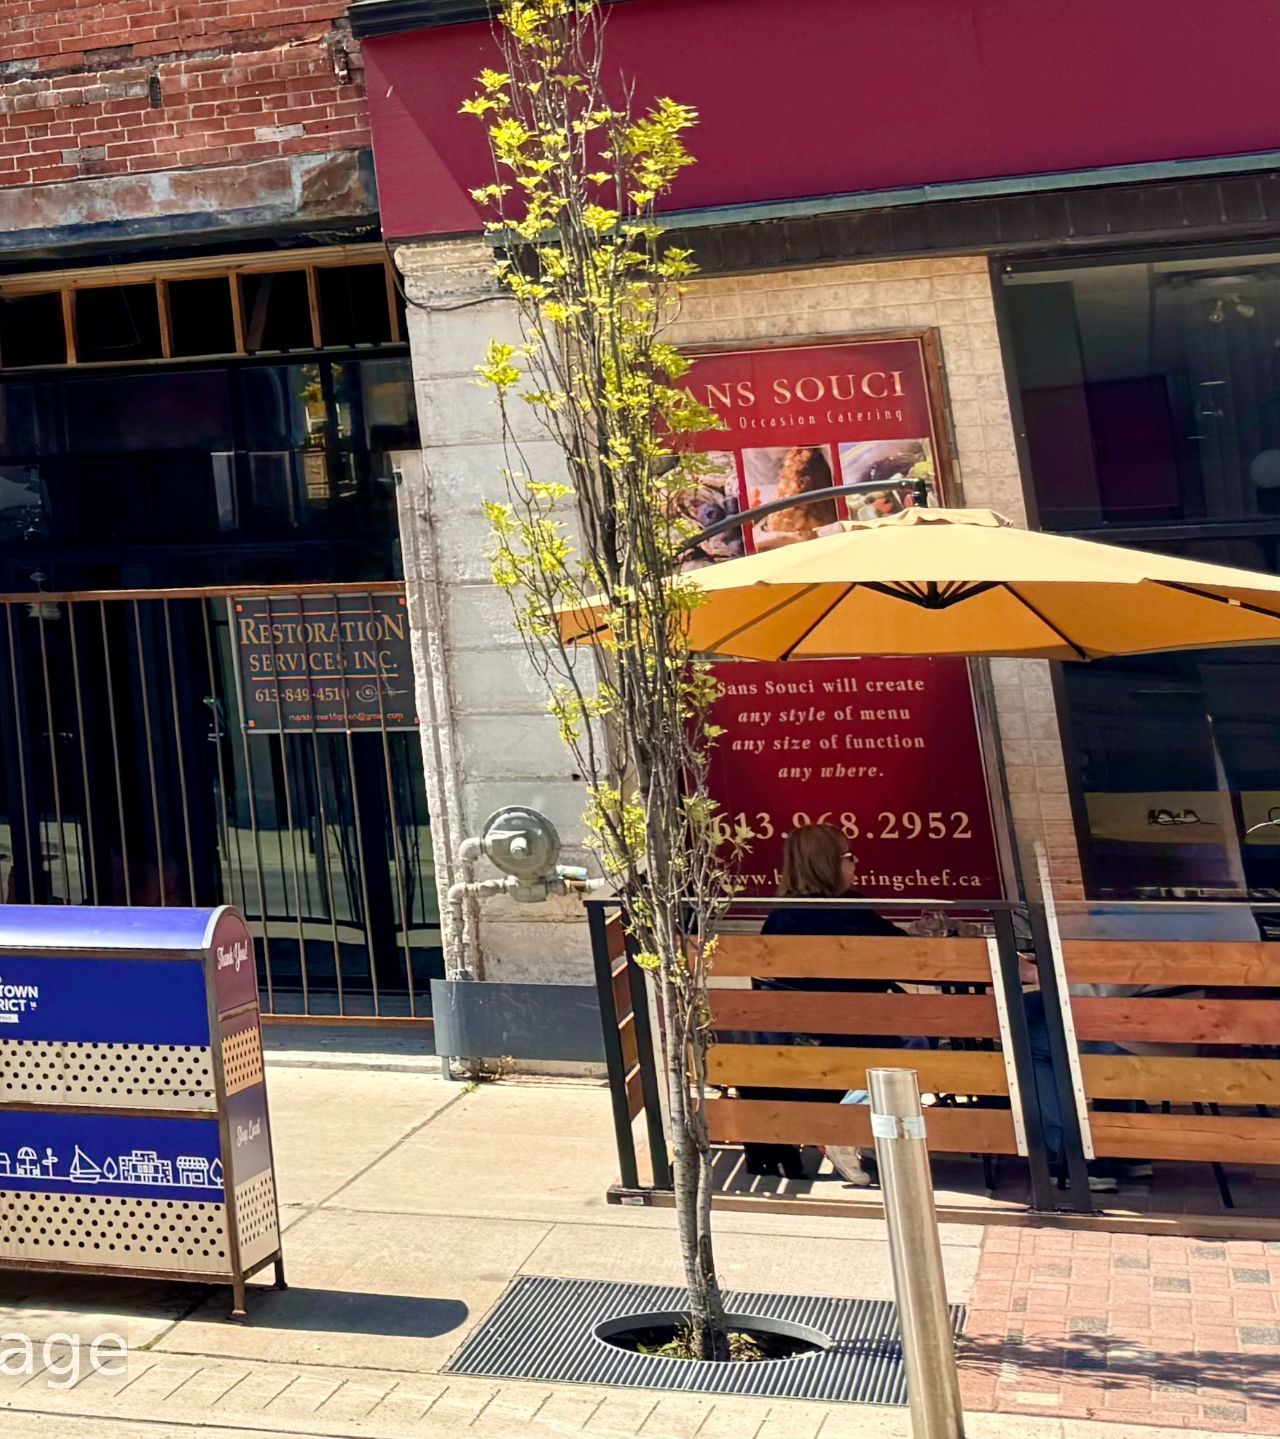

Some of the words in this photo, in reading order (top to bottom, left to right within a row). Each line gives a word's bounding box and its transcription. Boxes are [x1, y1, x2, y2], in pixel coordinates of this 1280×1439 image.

[676, 380, 756, 413] ANS
[772, 370, 906, 405] SOUCI
[739, 411, 816, 429] Occasion
[826, 408, 904, 424] Catering
[238, 614, 406, 645] RESTORATION
[249, 651, 348, 672] SERVICES
[354, 650, 398, 669] INC.
[717, 681, 758, 697] Sans
[765, 679, 814, 695] Souci
[822, 678, 858, 693] will
[865, 678, 925, 692] create
[737, 710, 772, 726] any
[779, 706, 826, 725] style
[834, 706, 853, 721] of
[860, 707, 911, 721] menu
[732, 738, 766, 754] any
[773, 735, 811, 750] size
[819, 734, 839, 749] of
[845, 734, 925, 749] function
[778, 766, 812, 781] any
[820, 763, 885, 778] where.
